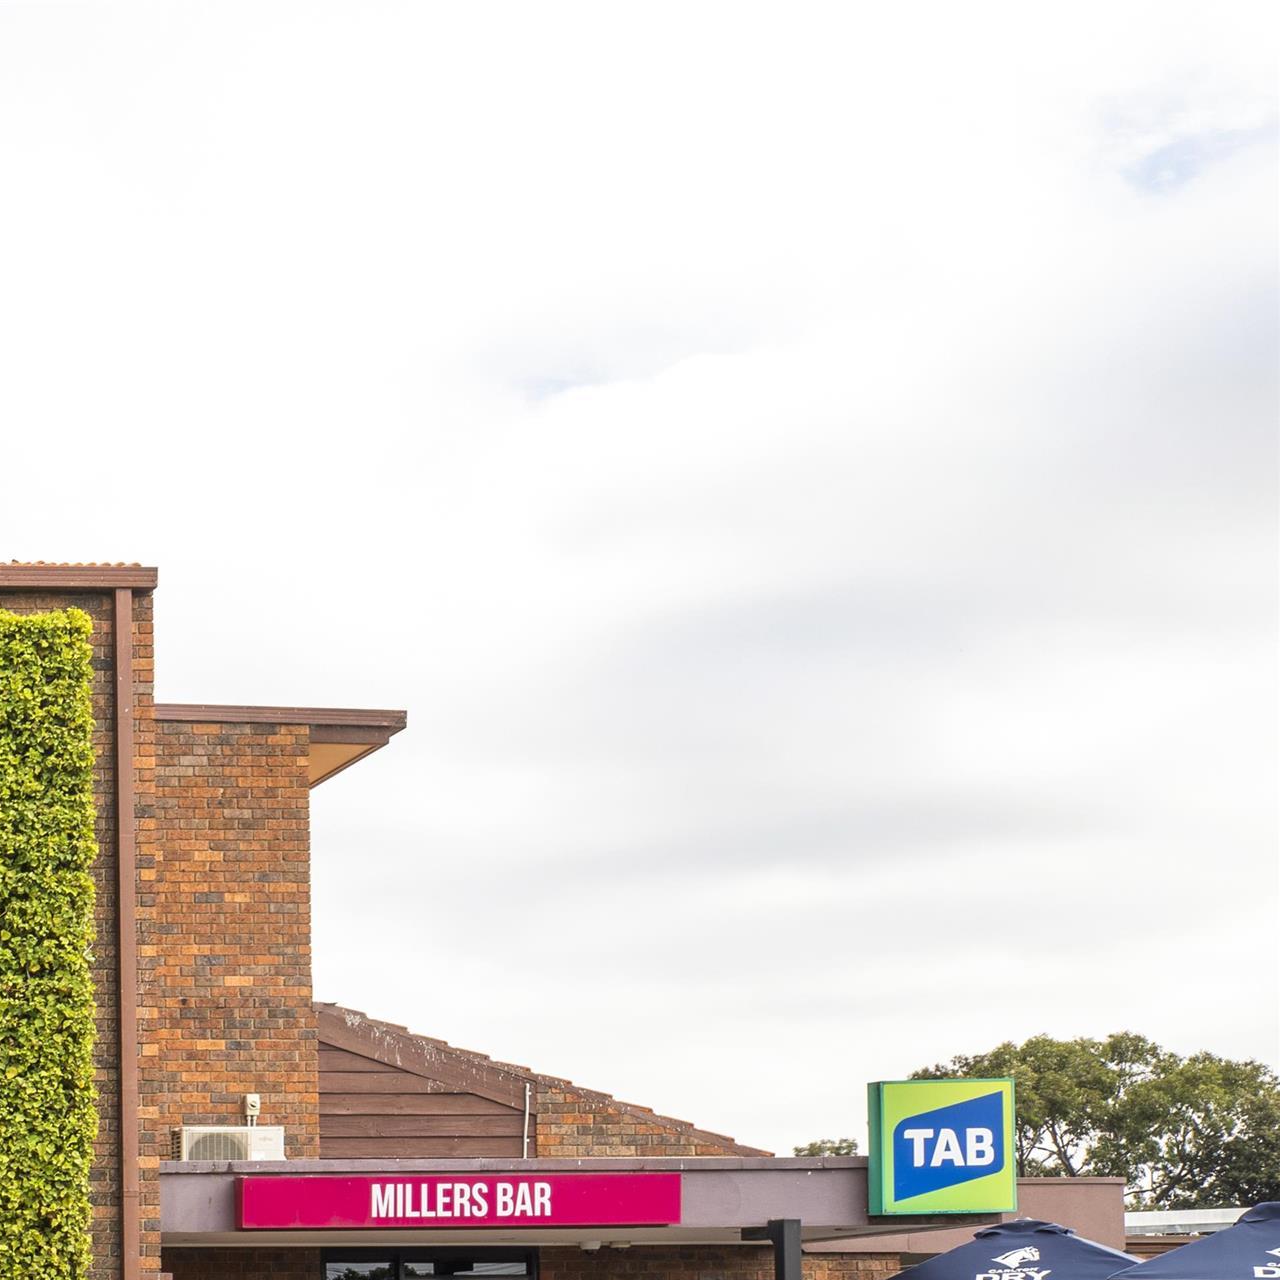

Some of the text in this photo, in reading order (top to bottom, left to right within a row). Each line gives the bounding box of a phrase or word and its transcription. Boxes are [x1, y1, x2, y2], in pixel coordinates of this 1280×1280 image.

[903, 1127, 995, 1168] TAB
[370, 1181, 553, 1219] MILLERS BAR
[987, 1266, 1040, 1274] CARLTON
